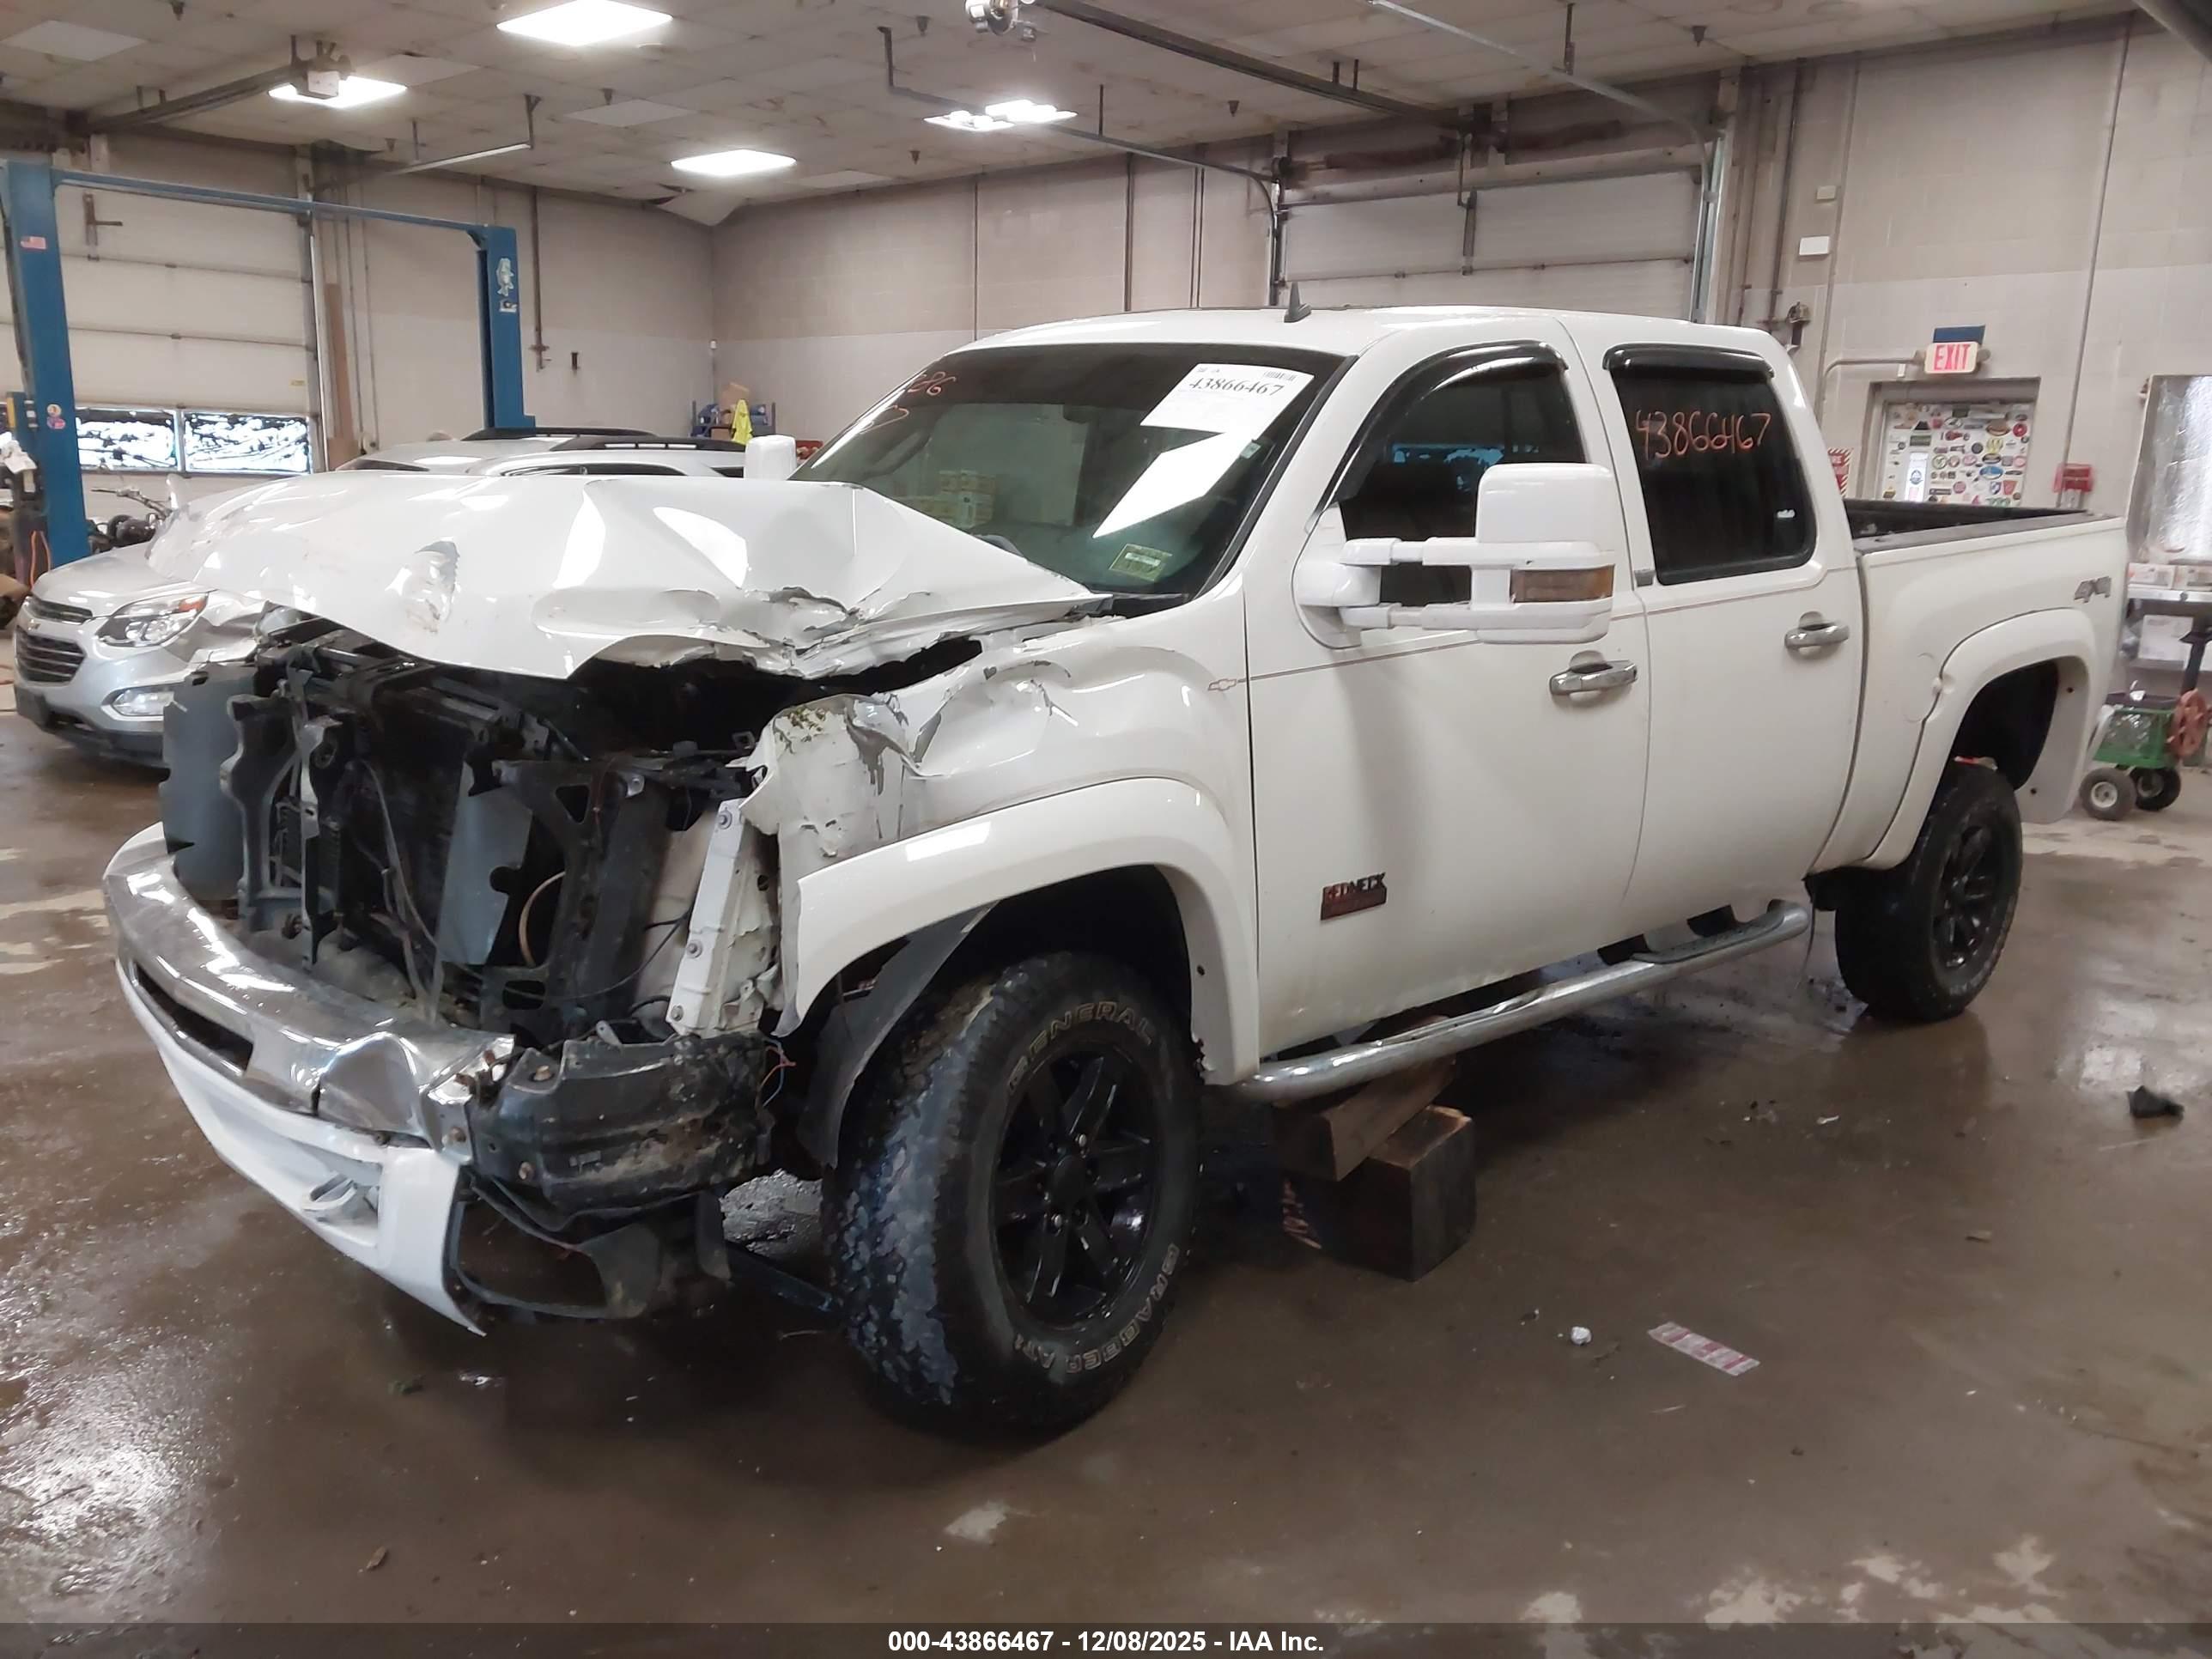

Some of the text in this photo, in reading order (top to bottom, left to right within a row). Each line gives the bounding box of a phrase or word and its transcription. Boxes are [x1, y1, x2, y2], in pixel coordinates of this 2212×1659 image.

[1934, 343, 1972, 371] EXIT
[1189, 378, 1285, 396] 43866467
[1636, 410, 1771, 460] 43866467
[1007, 1001, 1153, 1091] GENERAL
[1066, 1243, 1180, 1373] GRABBER
